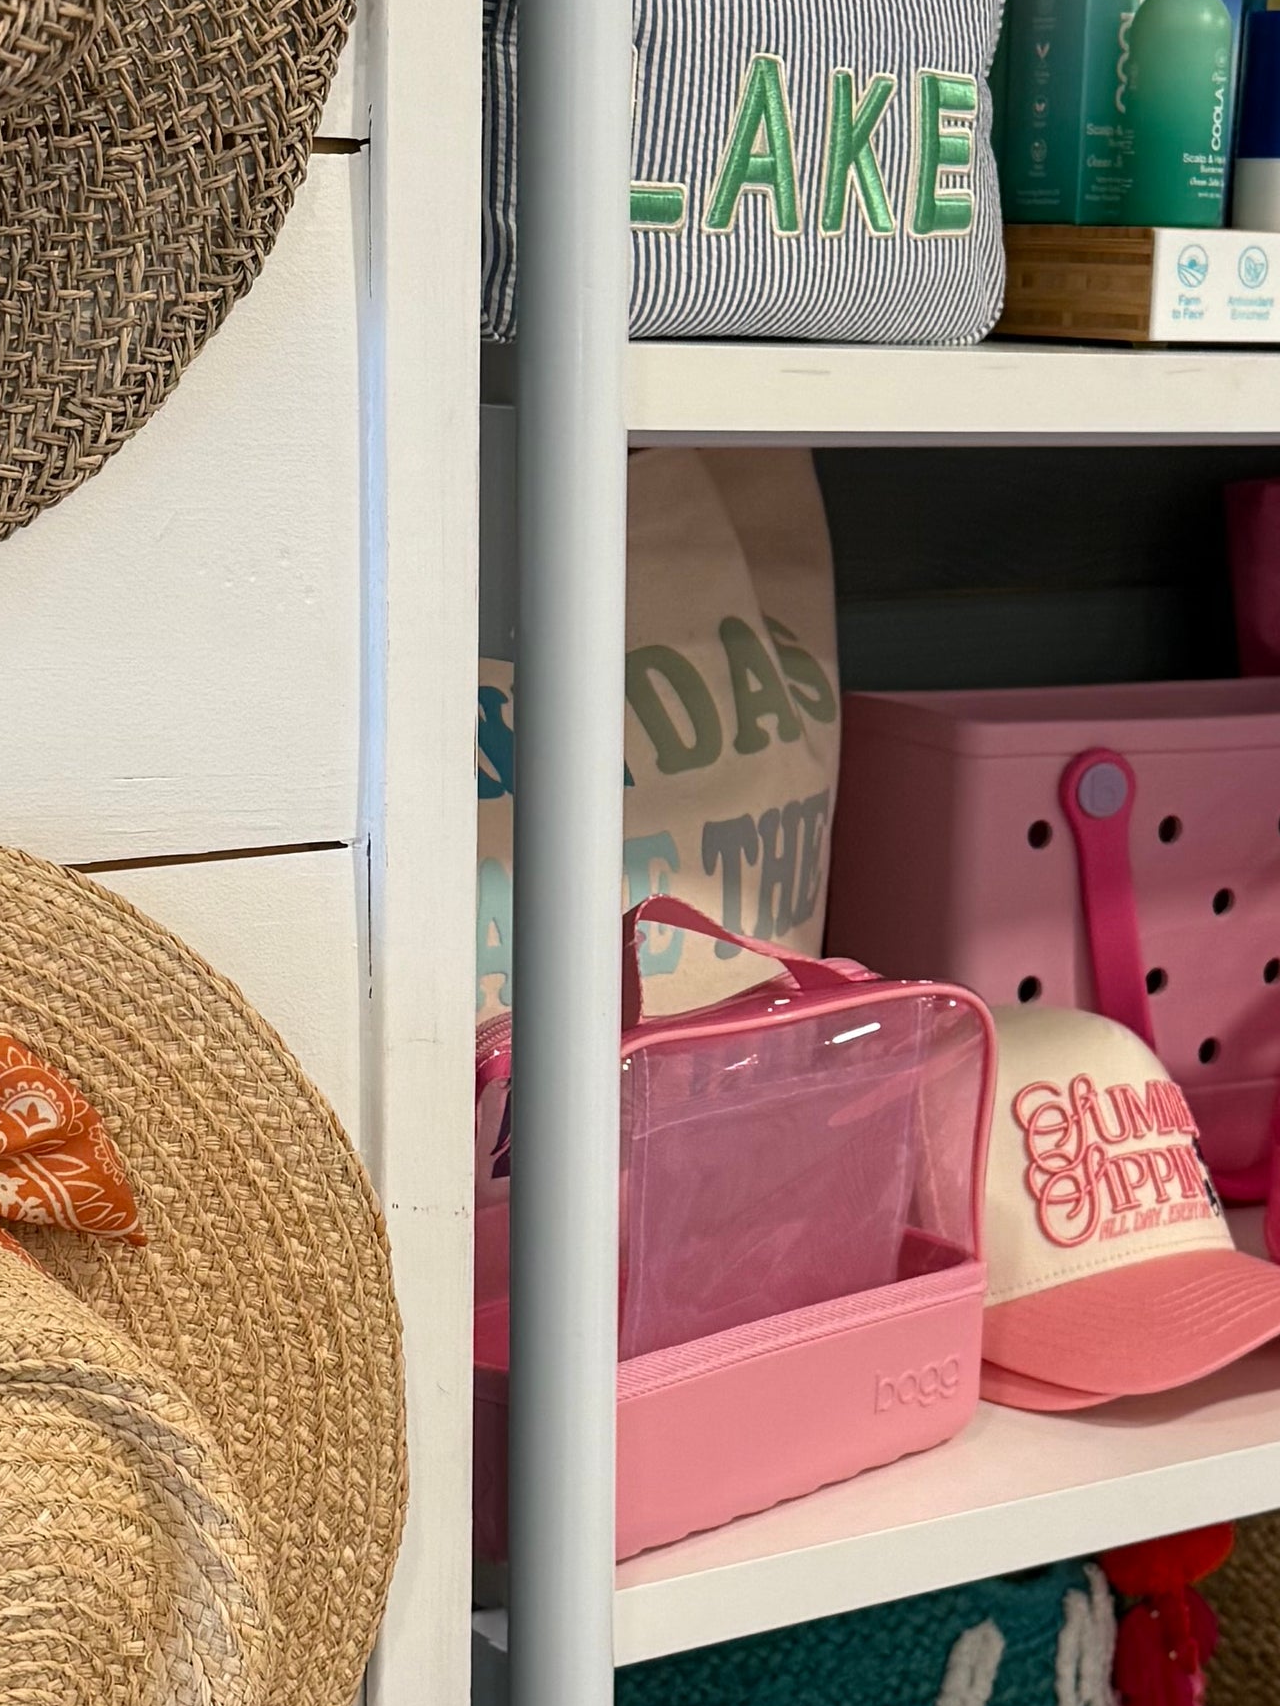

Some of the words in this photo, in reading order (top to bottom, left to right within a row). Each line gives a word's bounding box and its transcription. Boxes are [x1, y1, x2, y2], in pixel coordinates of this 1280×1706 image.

[1211, 88, 1225, 152] COOLA
[1013, 1072, 1200, 1174] SUMME
[871, 1355, 961, 1416] bogg
